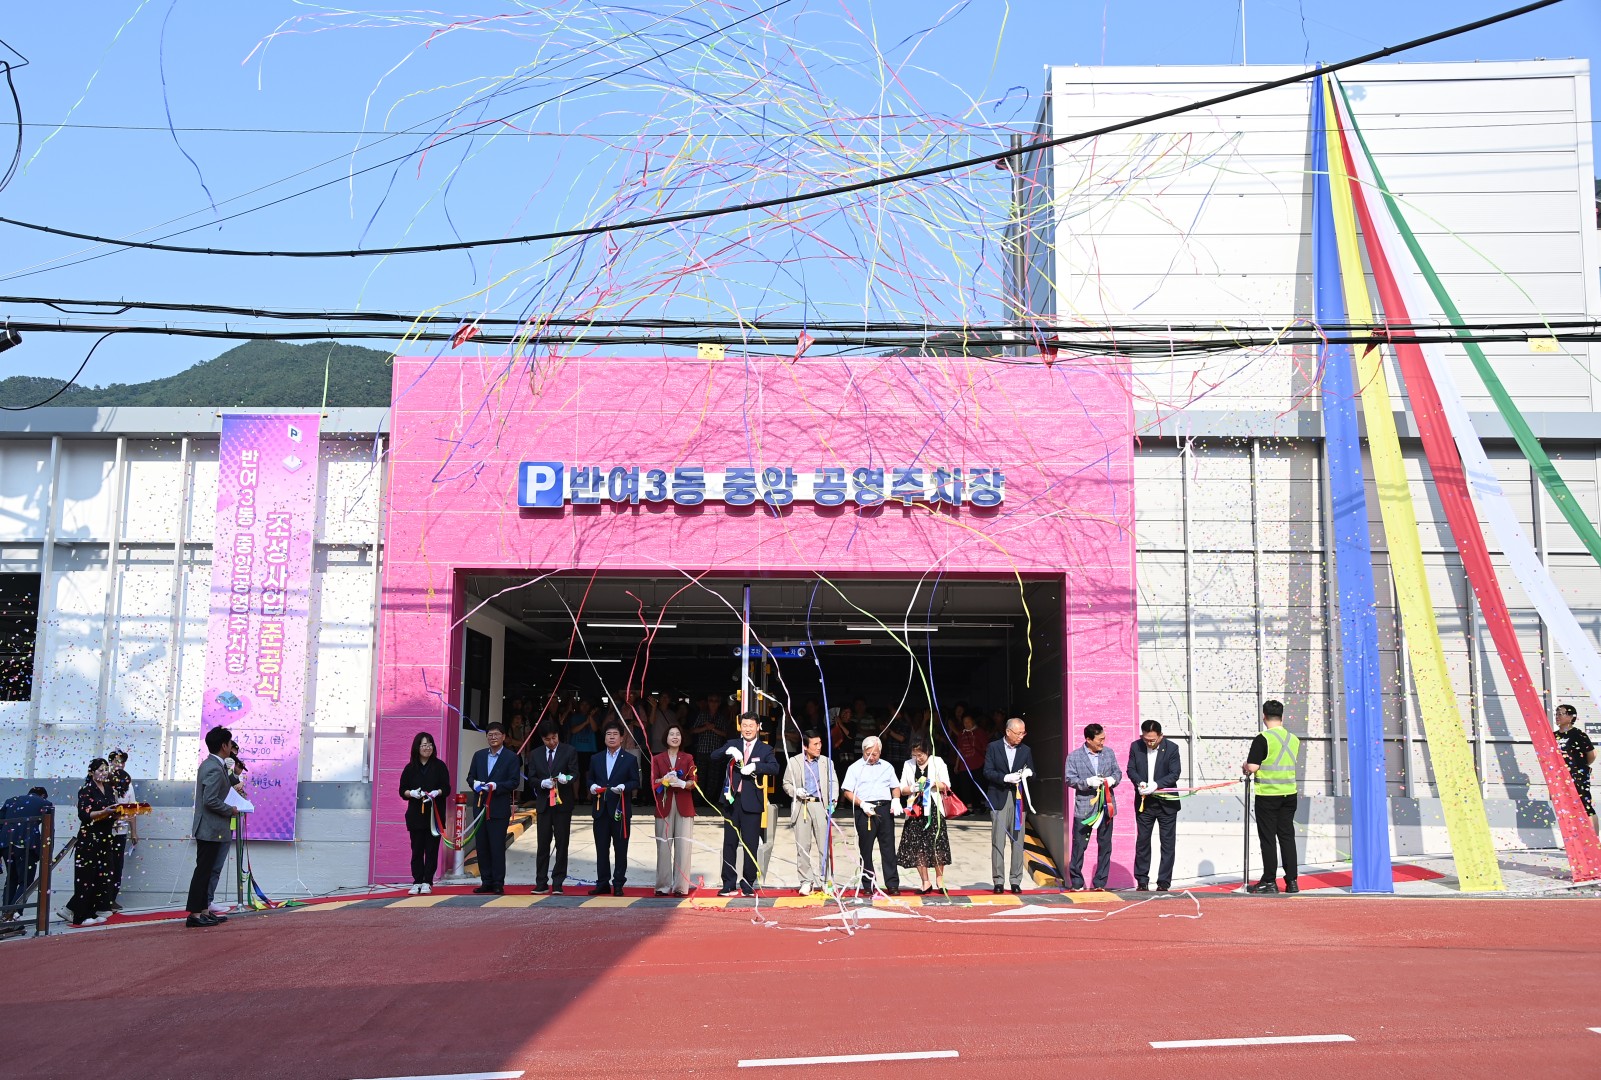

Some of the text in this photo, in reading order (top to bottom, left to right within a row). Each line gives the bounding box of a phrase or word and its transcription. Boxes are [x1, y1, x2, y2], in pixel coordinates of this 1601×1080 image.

[290, 427, 298, 438] P
[238, 450, 258, 525] 반여3동
[526, 466, 1004, 506] P 반여3동 중앙 공영주차장
[257, 513, 290, 700] 조성사업 준공식
